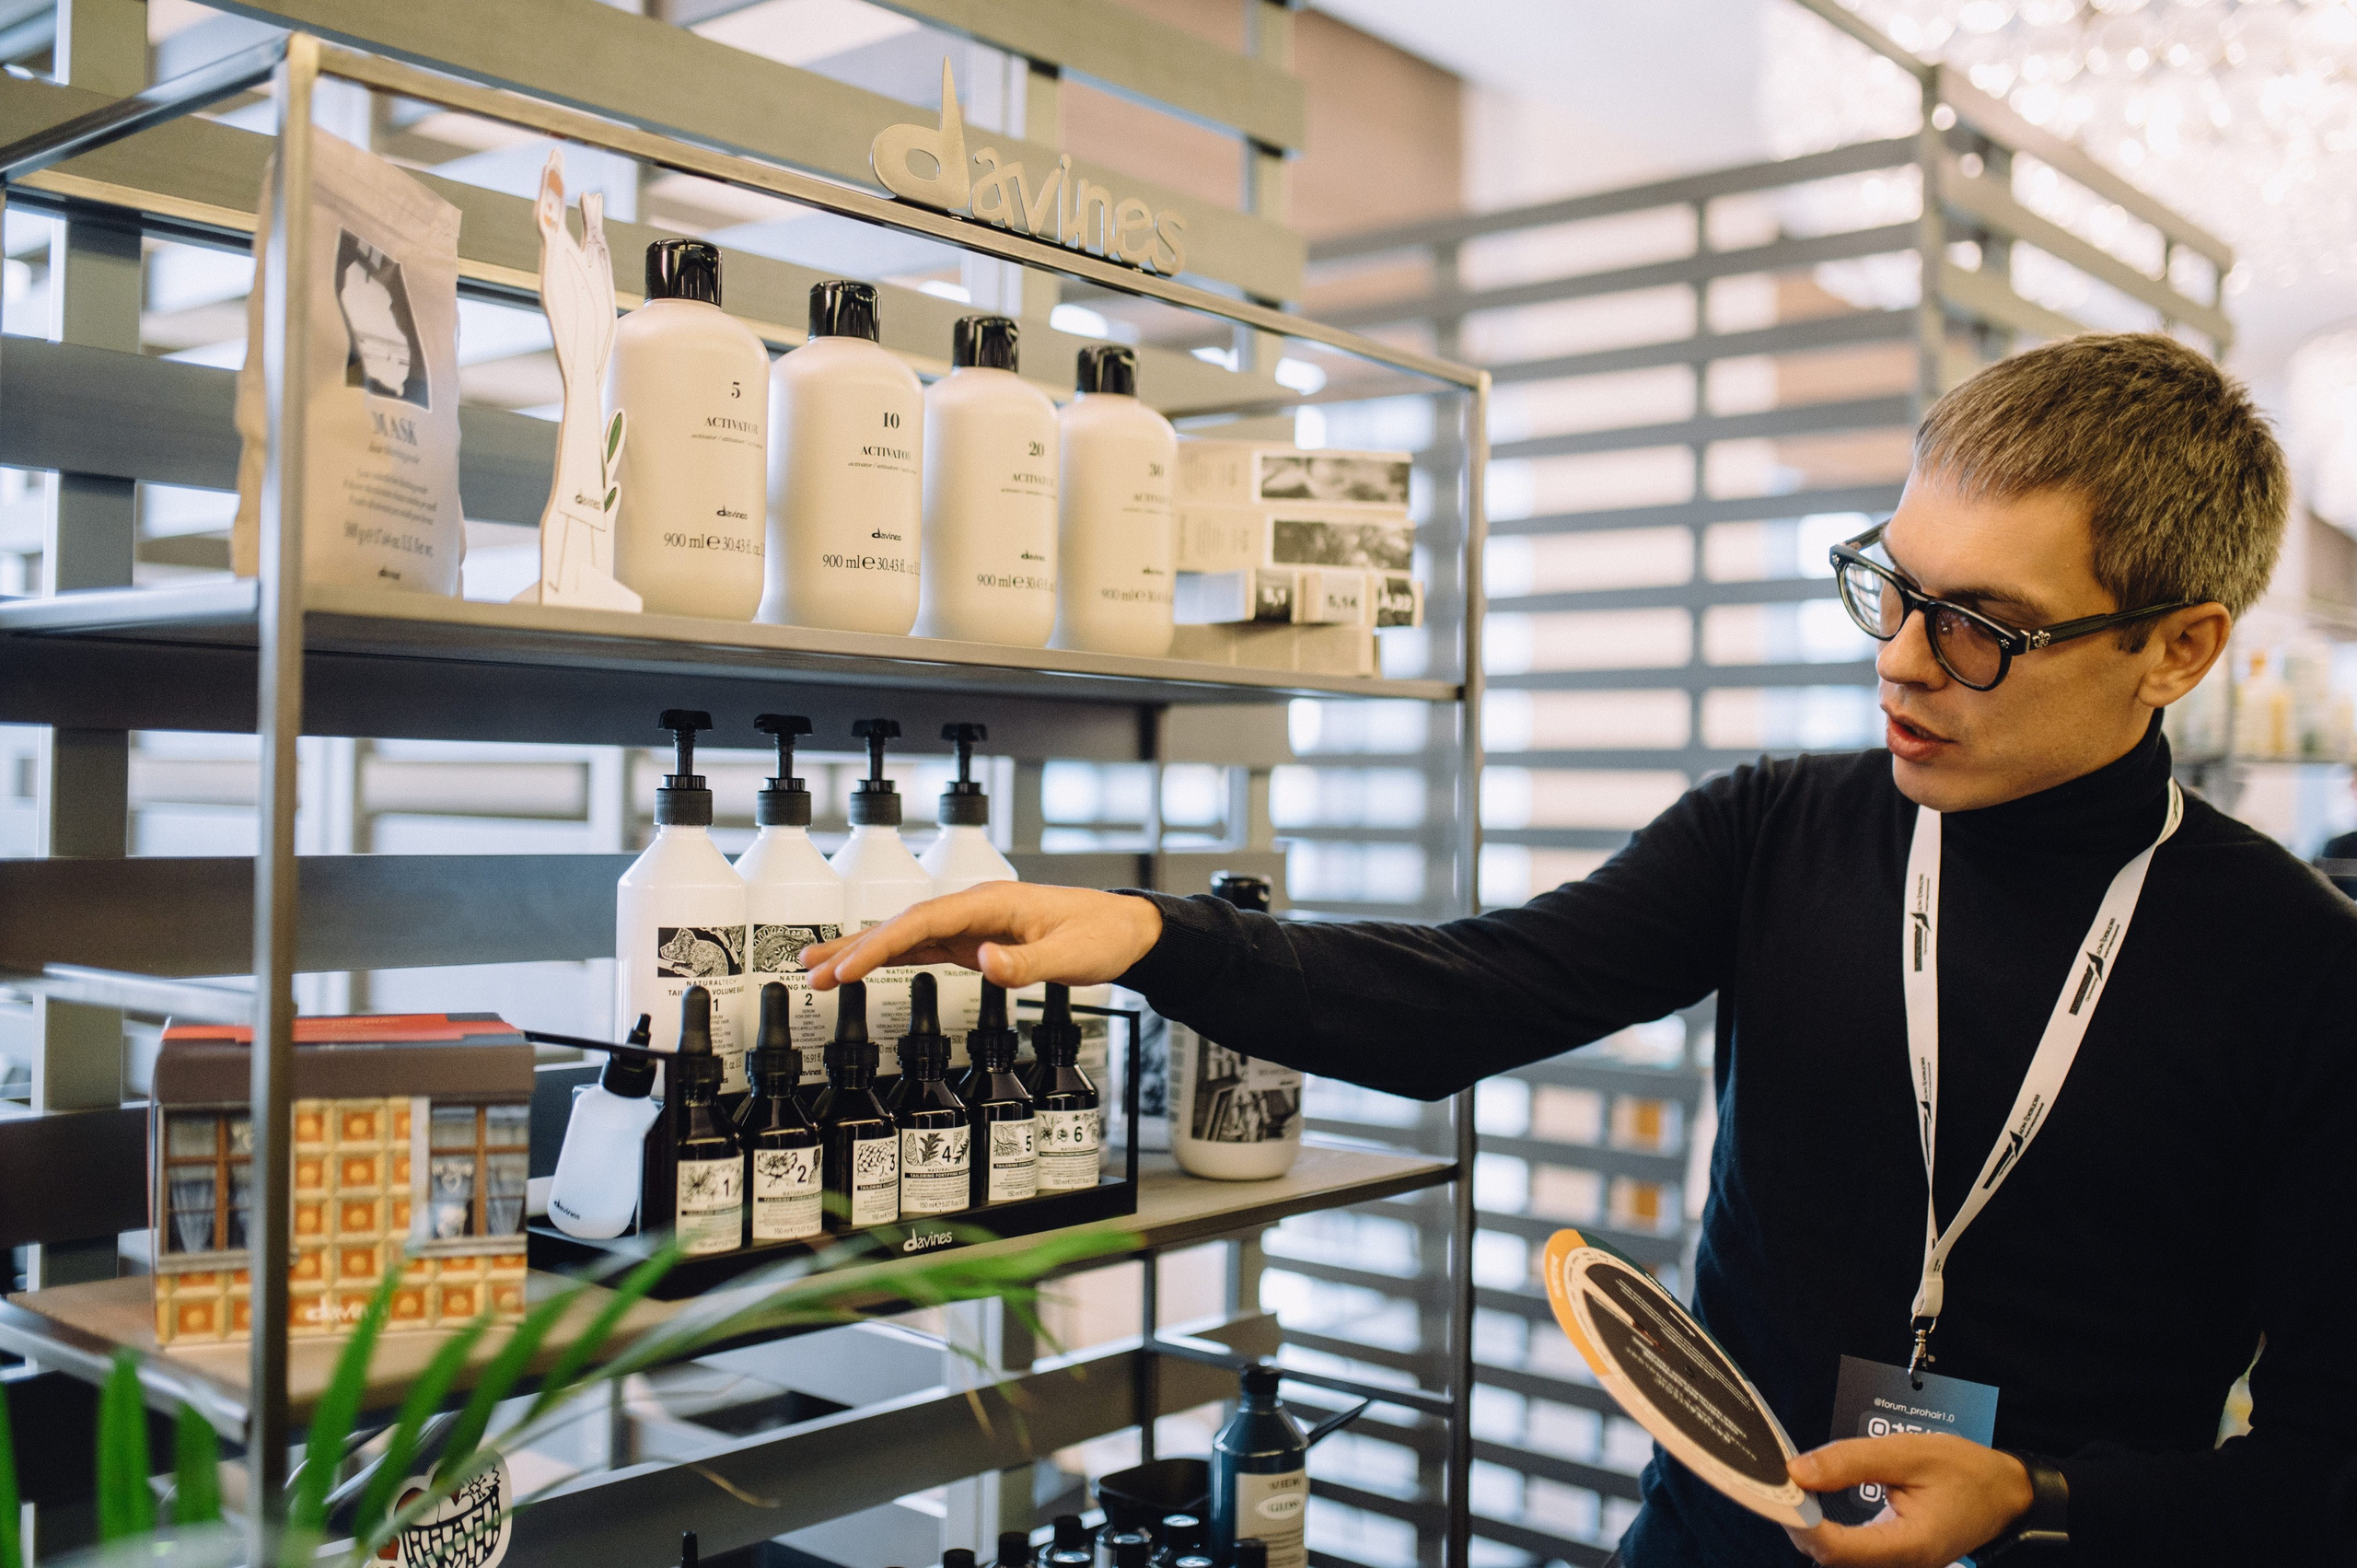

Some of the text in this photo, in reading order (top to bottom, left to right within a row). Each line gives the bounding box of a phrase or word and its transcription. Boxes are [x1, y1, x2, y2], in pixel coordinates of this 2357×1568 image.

[869, 55, 1189, 278] davines
[730, 381, 741, 399] 5
[704, 416, 759, 436] ACTIVATOR
[881, 411, 901, 430] 10
[860, 445, 912, 462] ACTIVATOR
[1028, 440, 1046, 458] 20
[1149, 462, 1165, 477] 30
[716, 505, 749, 520] davines
[663, 532, 687, 548] 900
[689, 533, 705, 549] ml
[722, 536, 746, 553] 30.43
[871, 527, 902, 542] davines
[822, 554, 844, 569] 900
[845, 554, 861, 570] ml
[877, 557, 900, 573] 30.43
[977, 574, 997, 587] 900
[998, 575, 1012, 588] ml
[865, 976, 903, 984] TAILORING
[712, 987, 737, 995] VOLUME
[805, 993, 813, 1006] 2
[713, 998, 719, 1012] 1
[801, 1068, 822, 1076] avines
[1026, 1134, 1032, 1152] 5
[1074, 1126, 1083, 1143] 6
[941, 1144, 952, 1163] 4
[889, 1154, 896, 1172] 3
[796, 1165, 807, 1184] 2
[723, 1179, 730, 1197] 1
[553, 1199, 581, 1221] davines
[903, 1227, 953, 1252] davines
[1873, 1396, 1956, 1423] @forum_prohair1.0
